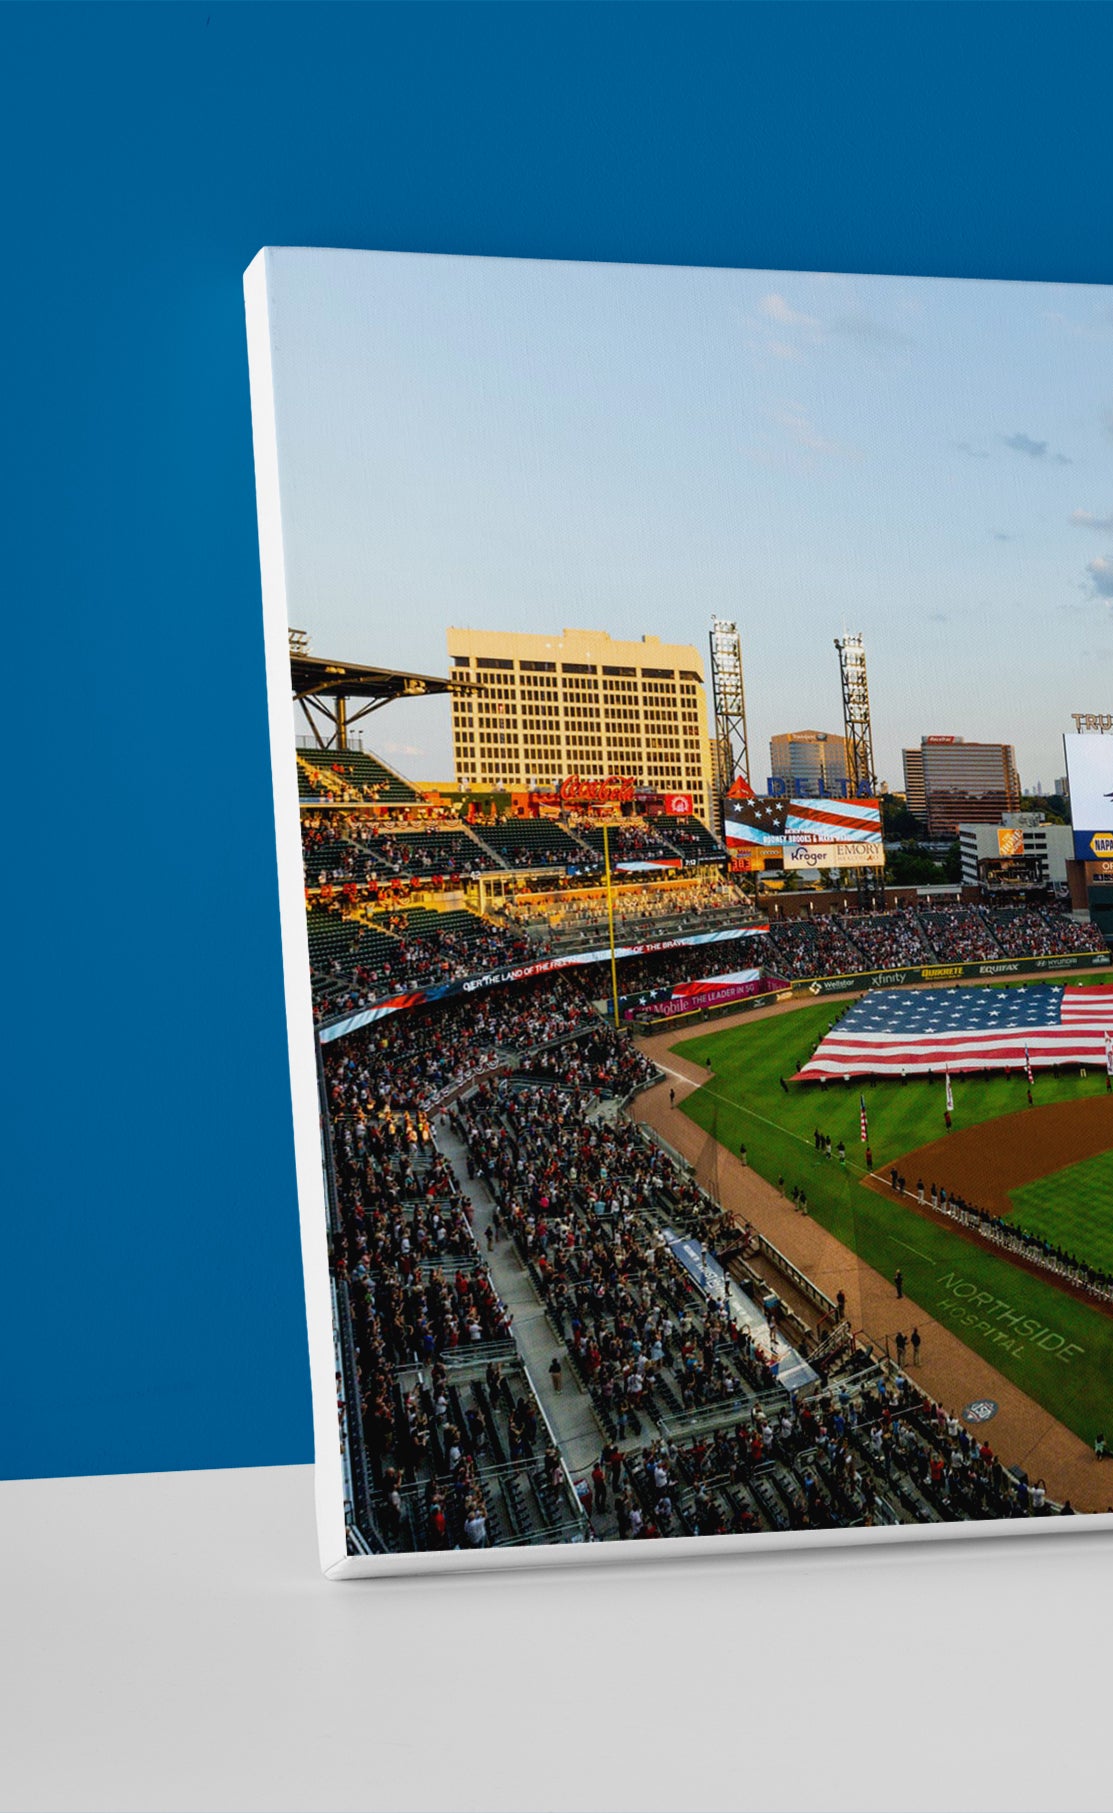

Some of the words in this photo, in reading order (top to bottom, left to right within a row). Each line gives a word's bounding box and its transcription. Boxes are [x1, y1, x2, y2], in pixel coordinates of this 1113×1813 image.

[766, 777, 873, 798] DELTA
[791, 847, 827, 867] Kroger
[837, 843, 879, 855] EMORY
[646, 942, 662, 951] THE
[483, 974, 501, 986] THE
[501, 969, 523, 982] LAND
[524, 966, 533, 976] OF
[535, 962, 549, 973] THE
[921, 967, 964, 977] QUIKRETE
[979, 963, 1019, 974] EQUIFAX
[871, 972, 907, 986] xfinity
[692, 995, 707, 1005] THE
[707, 988, 736, 1002] LEADER
[737, 986, 745, 995] IN
[937, 1272, 1085, 1363] NORTHSIDE
[937, 1299, 1025, 1360] HOSPITAL
